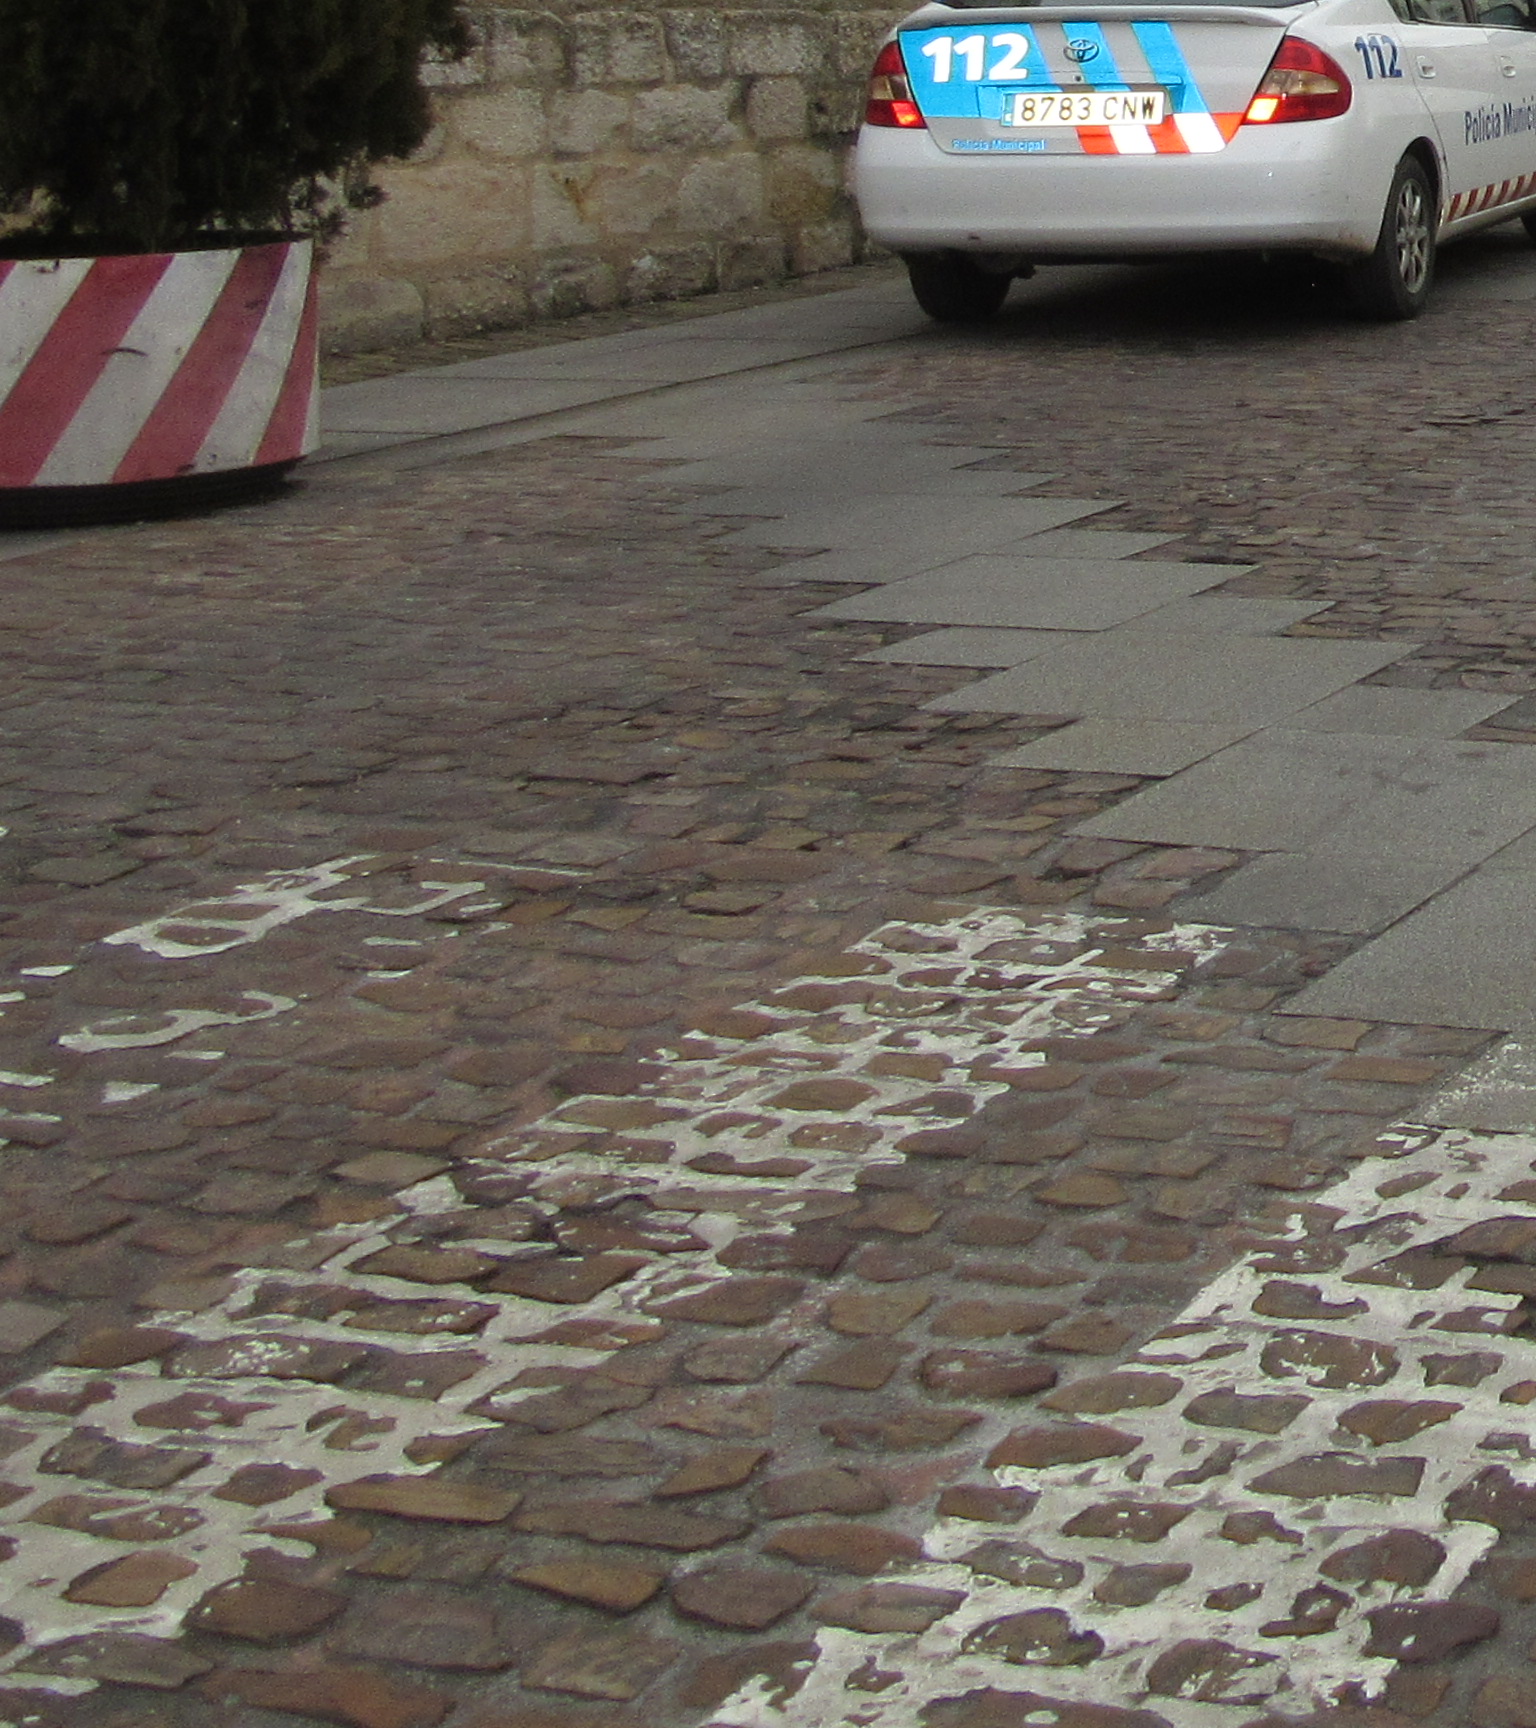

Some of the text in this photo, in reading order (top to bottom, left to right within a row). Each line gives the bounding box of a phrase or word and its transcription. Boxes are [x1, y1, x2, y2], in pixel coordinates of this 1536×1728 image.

[921, 32, 1030, 83] 112
[1354, 33, 1403, 80] 112
[1020, 96, 1156, 122] 8783 CNW
[991, 138, 1045, 152] Municipal
